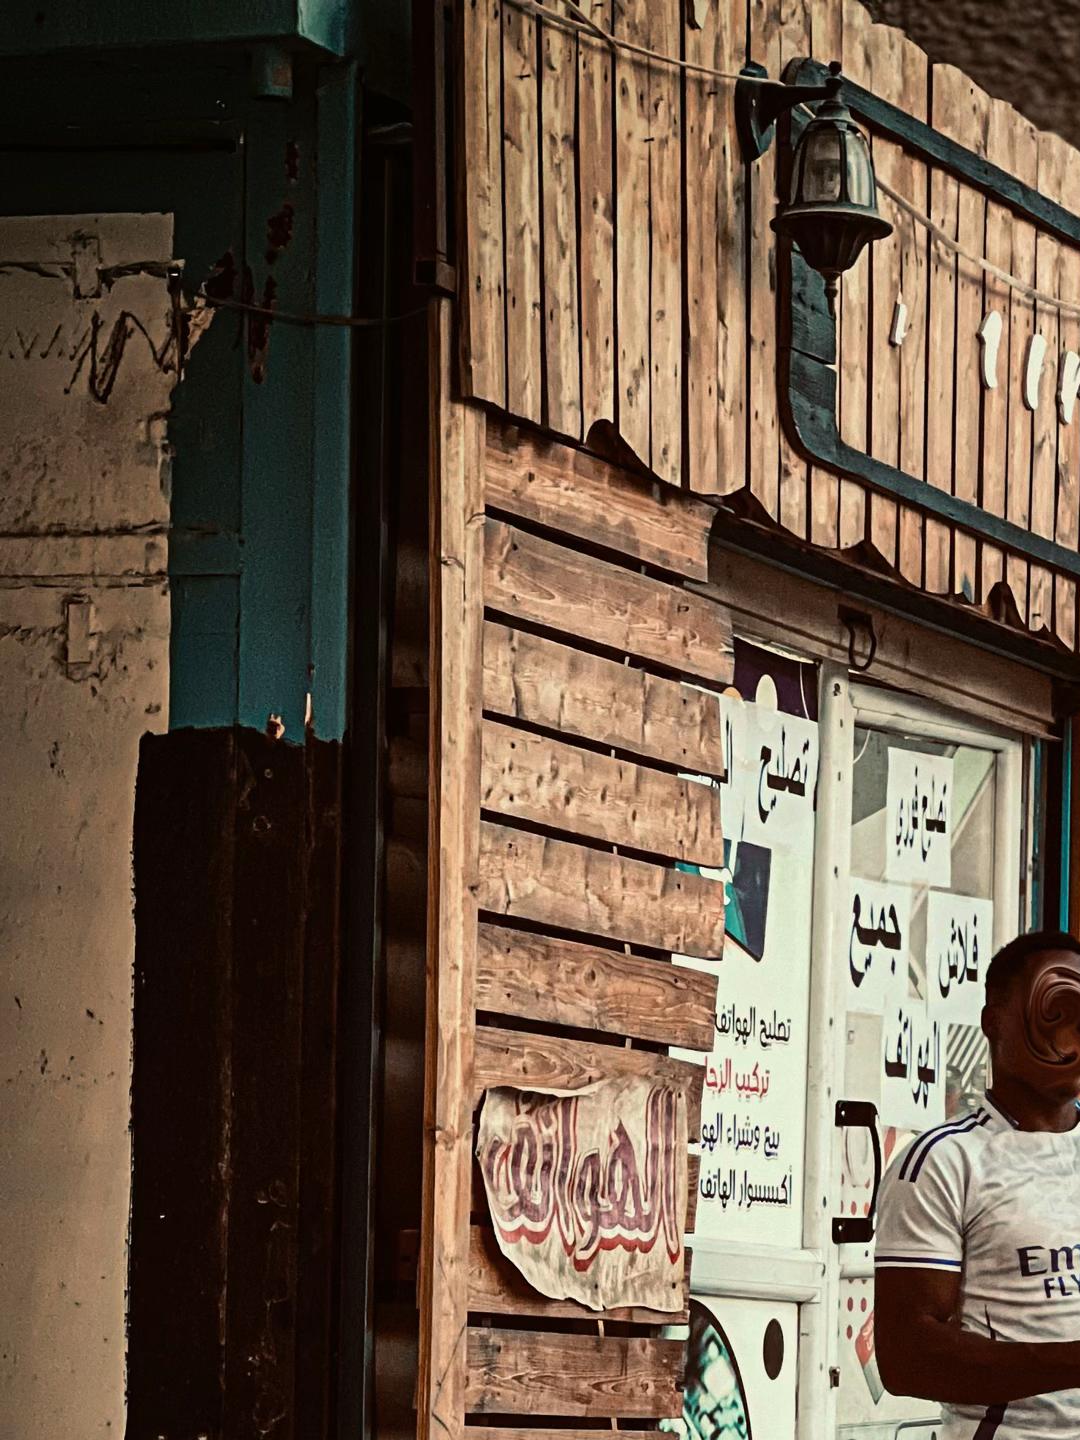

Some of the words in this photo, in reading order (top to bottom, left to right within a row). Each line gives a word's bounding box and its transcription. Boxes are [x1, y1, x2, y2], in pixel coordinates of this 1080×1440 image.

[758, 725, 810, 824] تصليح
[921, 774, 947, 862] تصليح
[849, 893, 902, 988] جميع
[938, 913, 978, 999] فلاش
[714, 1003, 756, 1045] الهواتف
[759, 1009, 792, 1047] تصليح
[885, 1007, 941, 1109] الهواتف
[735, 1061, 770, 1098] تركيب
[727, 1113, 760, 1151] وشراء
[764, 1124, 780, 1157] بيع
[700, 1167, 736, 1208] الهاتف
